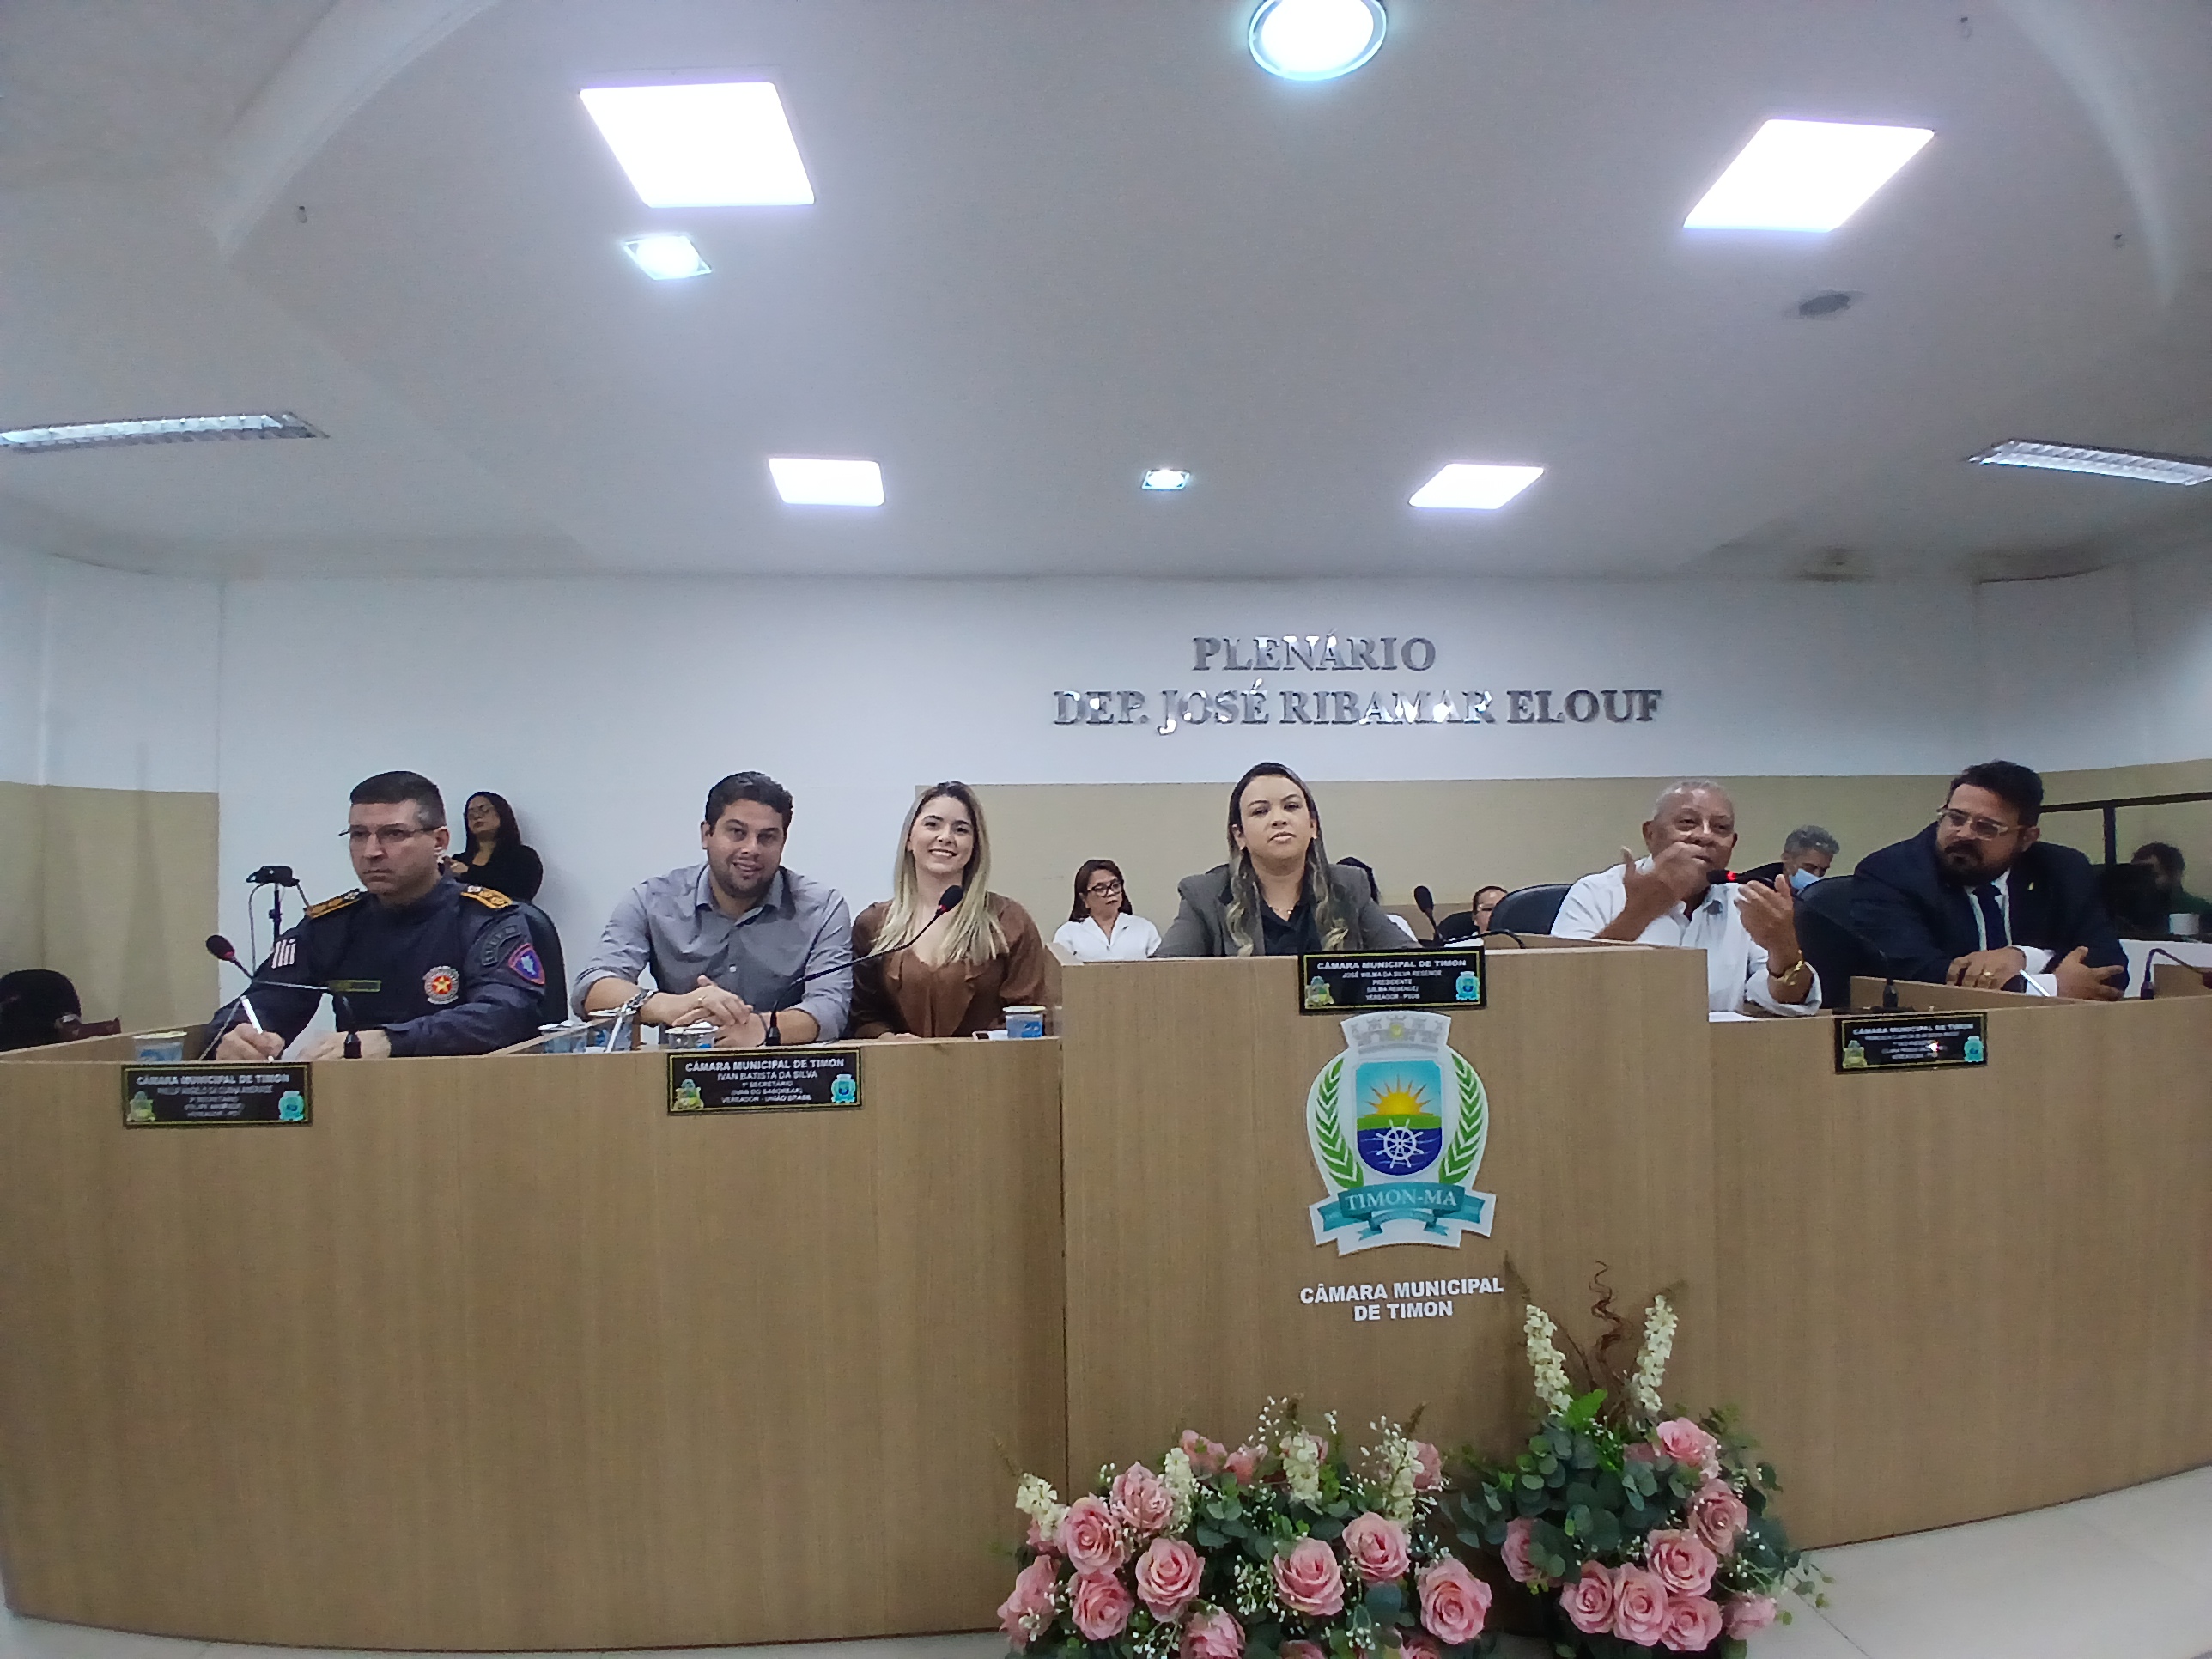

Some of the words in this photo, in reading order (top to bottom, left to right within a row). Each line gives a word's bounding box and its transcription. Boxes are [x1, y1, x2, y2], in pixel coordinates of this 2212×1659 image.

[1192, 629, 1436, 672] PLENÁRIO
[1053, 690, 1149, 725] DEP.
[1157, 678, 1270, 735] JOSÉ
[1279, 690, 1497, 725] RIBAMAR
[1506, 689, 1662, 724] ELOUF
[1317, 961, 1359, 969] CÂMARA
[732, 1059, 791, 1071] MUNICIPAL
[793, 1059, 807, 1069] DE
[810, 1057, 845, 1068] TIMON
[717, 1073, 738, 1081] IVAN
[740, 1071, 777, 1080] BATISTA
[778, 1071, 791, 1079] DA
[793, 1070, 818, 1079] SILVA
[1345, 1189, 1457, 1210] TIMON-MA
[1300, 1283, 1388, 1304] CÂMARA
[1394, 1277, 1504, 1297] MUNICIPAL
[1354, 1304, 1382, 1322] DE
[1387, 1301, 1453, 1319] TIMON
